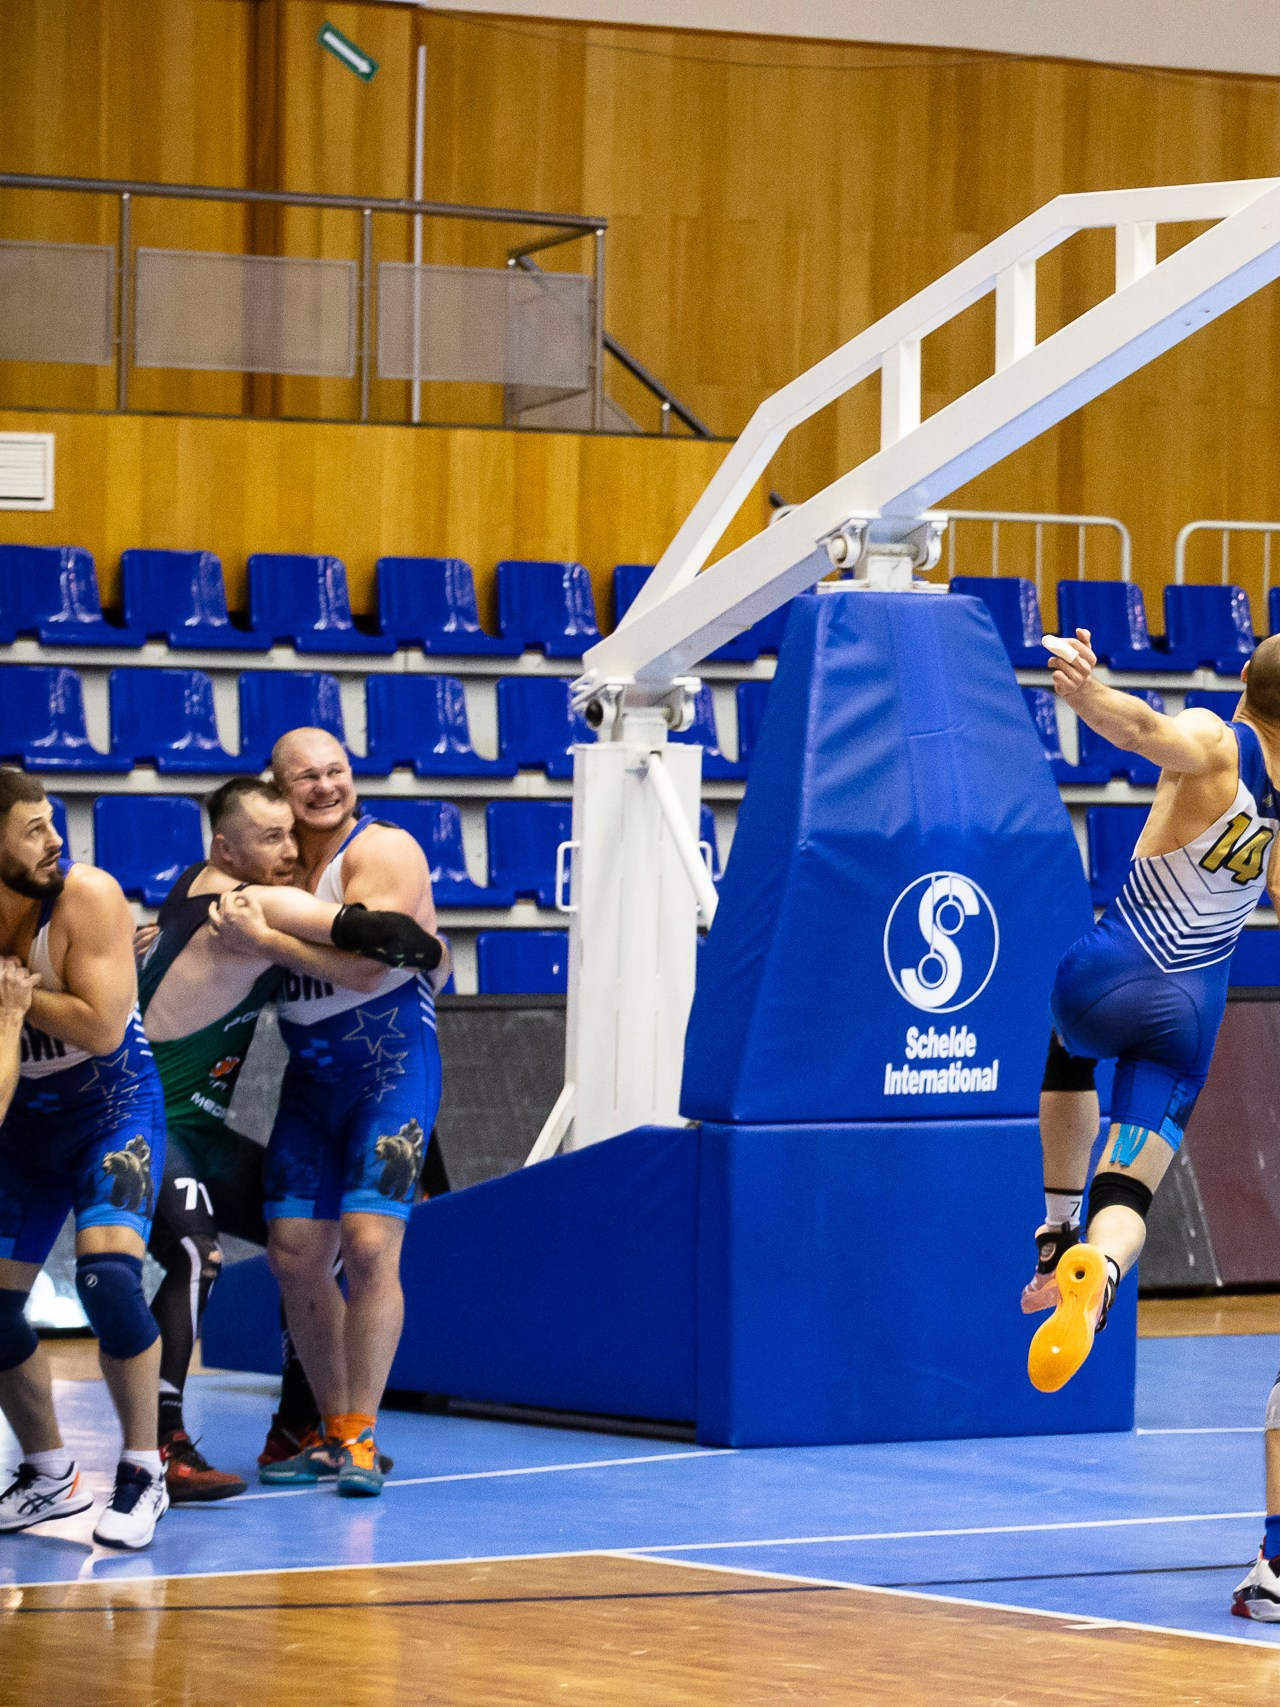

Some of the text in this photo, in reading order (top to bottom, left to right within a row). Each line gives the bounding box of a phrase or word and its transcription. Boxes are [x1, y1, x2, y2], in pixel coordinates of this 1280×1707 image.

[1198, 811, 1274, 886] 14
[904, 1025, 977, 1060] Schelde
[884, 1059, 999, 1096] International
